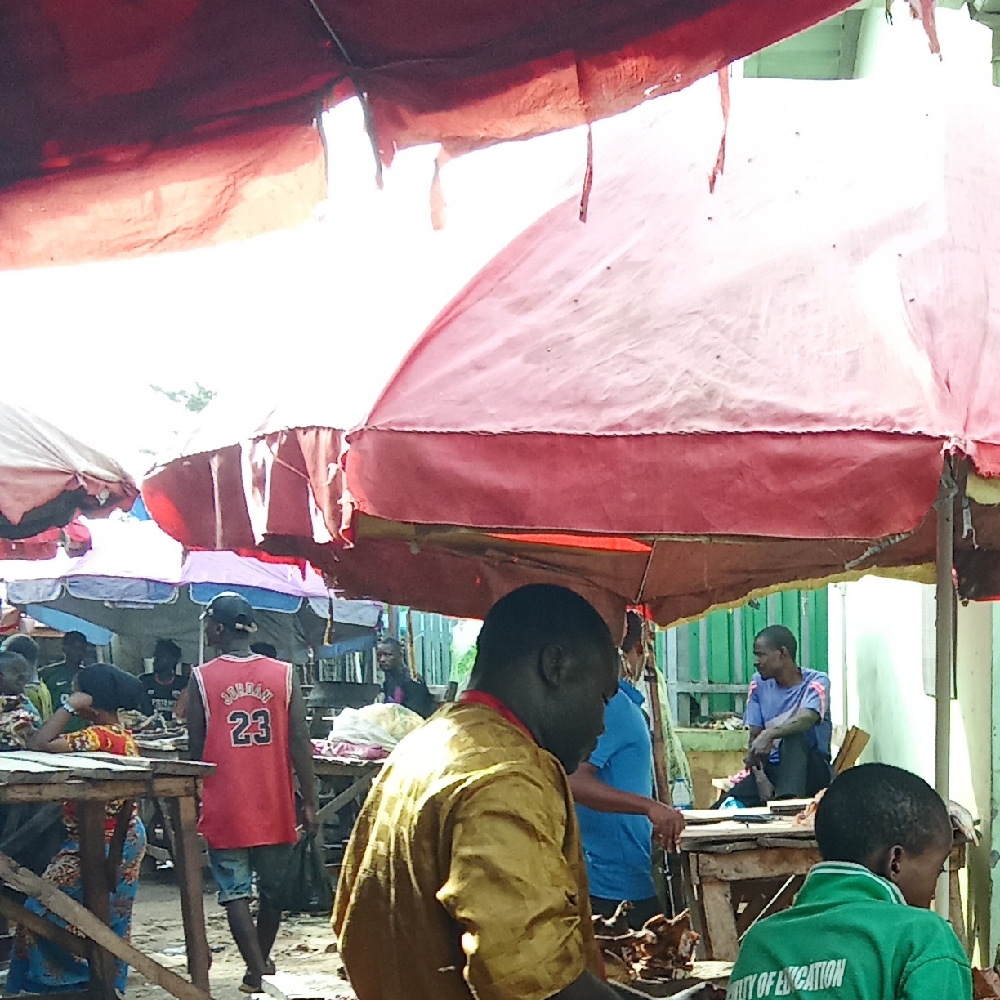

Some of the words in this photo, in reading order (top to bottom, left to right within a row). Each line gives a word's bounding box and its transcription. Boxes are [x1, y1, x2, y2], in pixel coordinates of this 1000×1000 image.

[221, 682, 274, 705] JORDAN
[227, 708, 272, 747] 23
[757, 971, 777, 998] OF
